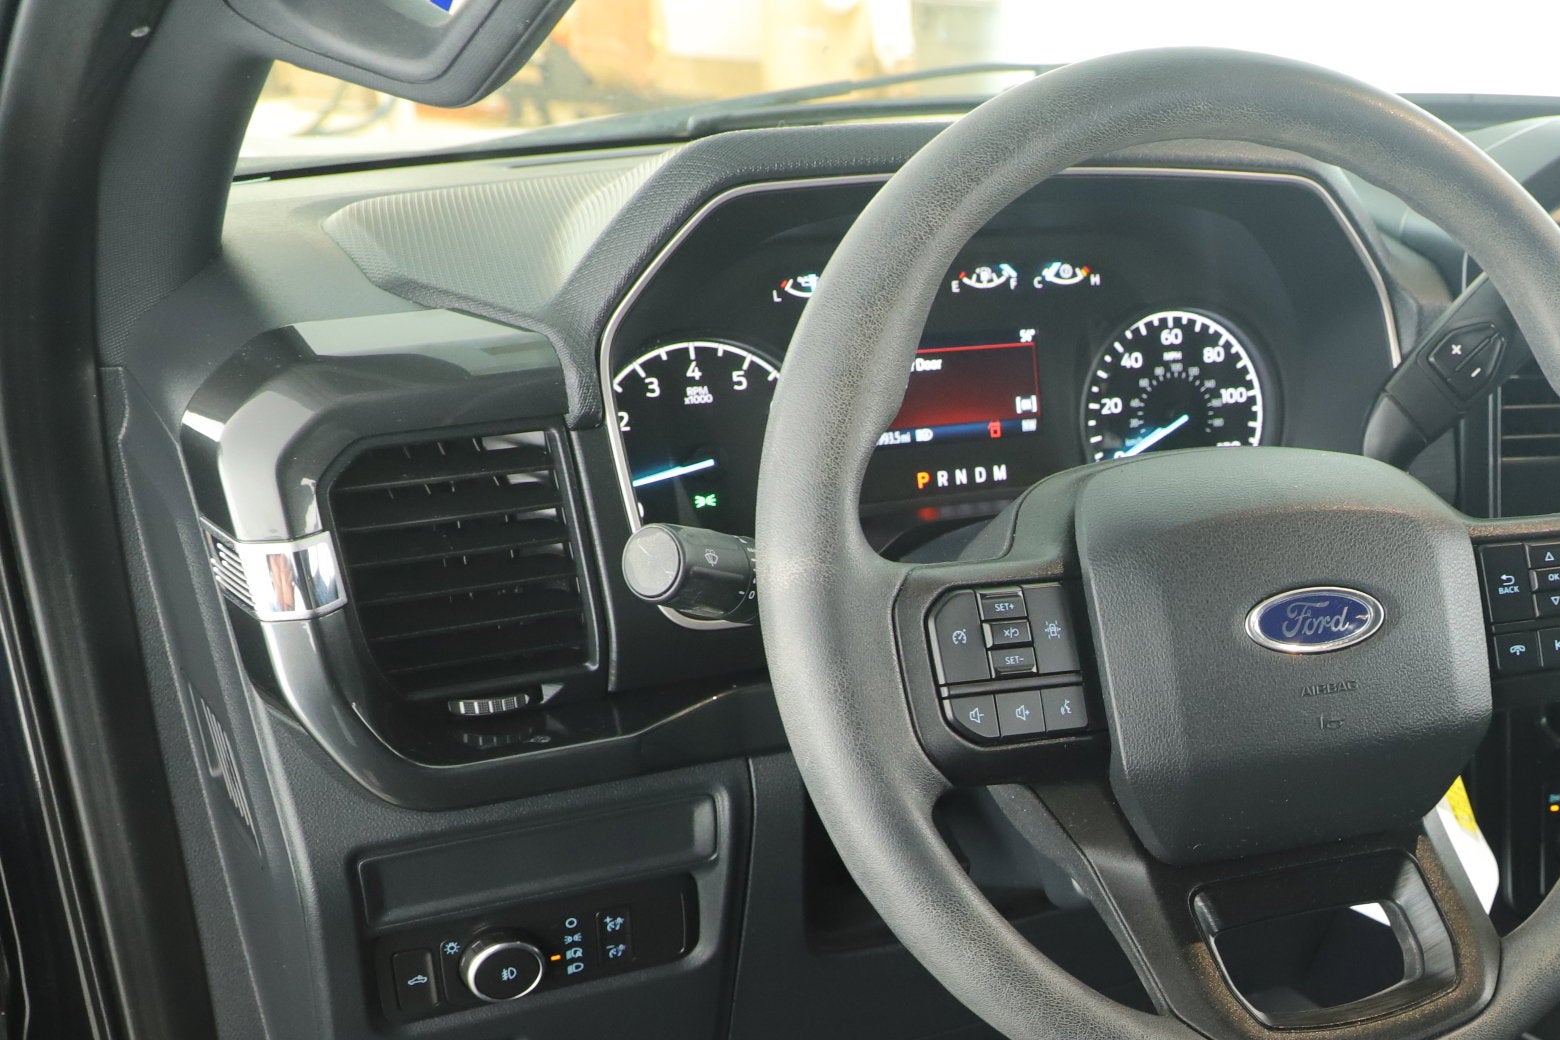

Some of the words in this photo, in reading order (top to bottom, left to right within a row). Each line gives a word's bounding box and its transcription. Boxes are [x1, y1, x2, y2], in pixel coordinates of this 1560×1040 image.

[951, 281, 960, 293] E
[1010, 278, 1018, 290] F
[1033, 277, 1042, 289] C
[1090, 274, 1101, 286] H
[1160, 328, 1183, 345] 60
[1120, 352, 1143, 369] 40
[1202, 347, 1225, 363] 80
[686, 361, 702, 380] 4
[915, 358, 942, 372] Door
[644, 377, 661, 397] 3
[732, 371, 748, 390] 5
[686, 385, 709, 396] RPM
[1220, 387, 1247, 404] 100
[1101, 397, 1123, 415] 20
[617, 411, 631, 431] 2
[917, 471, 930, 489] P
[937, 470, 949, 487] R
[955, 468, 968, 486] N
[974, 466, 987, 483] D
[993, 464, 1008, 481] M
[1548, 573, 1560, 581] OK
[1498, 586, 1520, 595] BACK
[1281, 601, 1350, 638] Ford
[1301, 680, 1359, 697] AIRBAG
